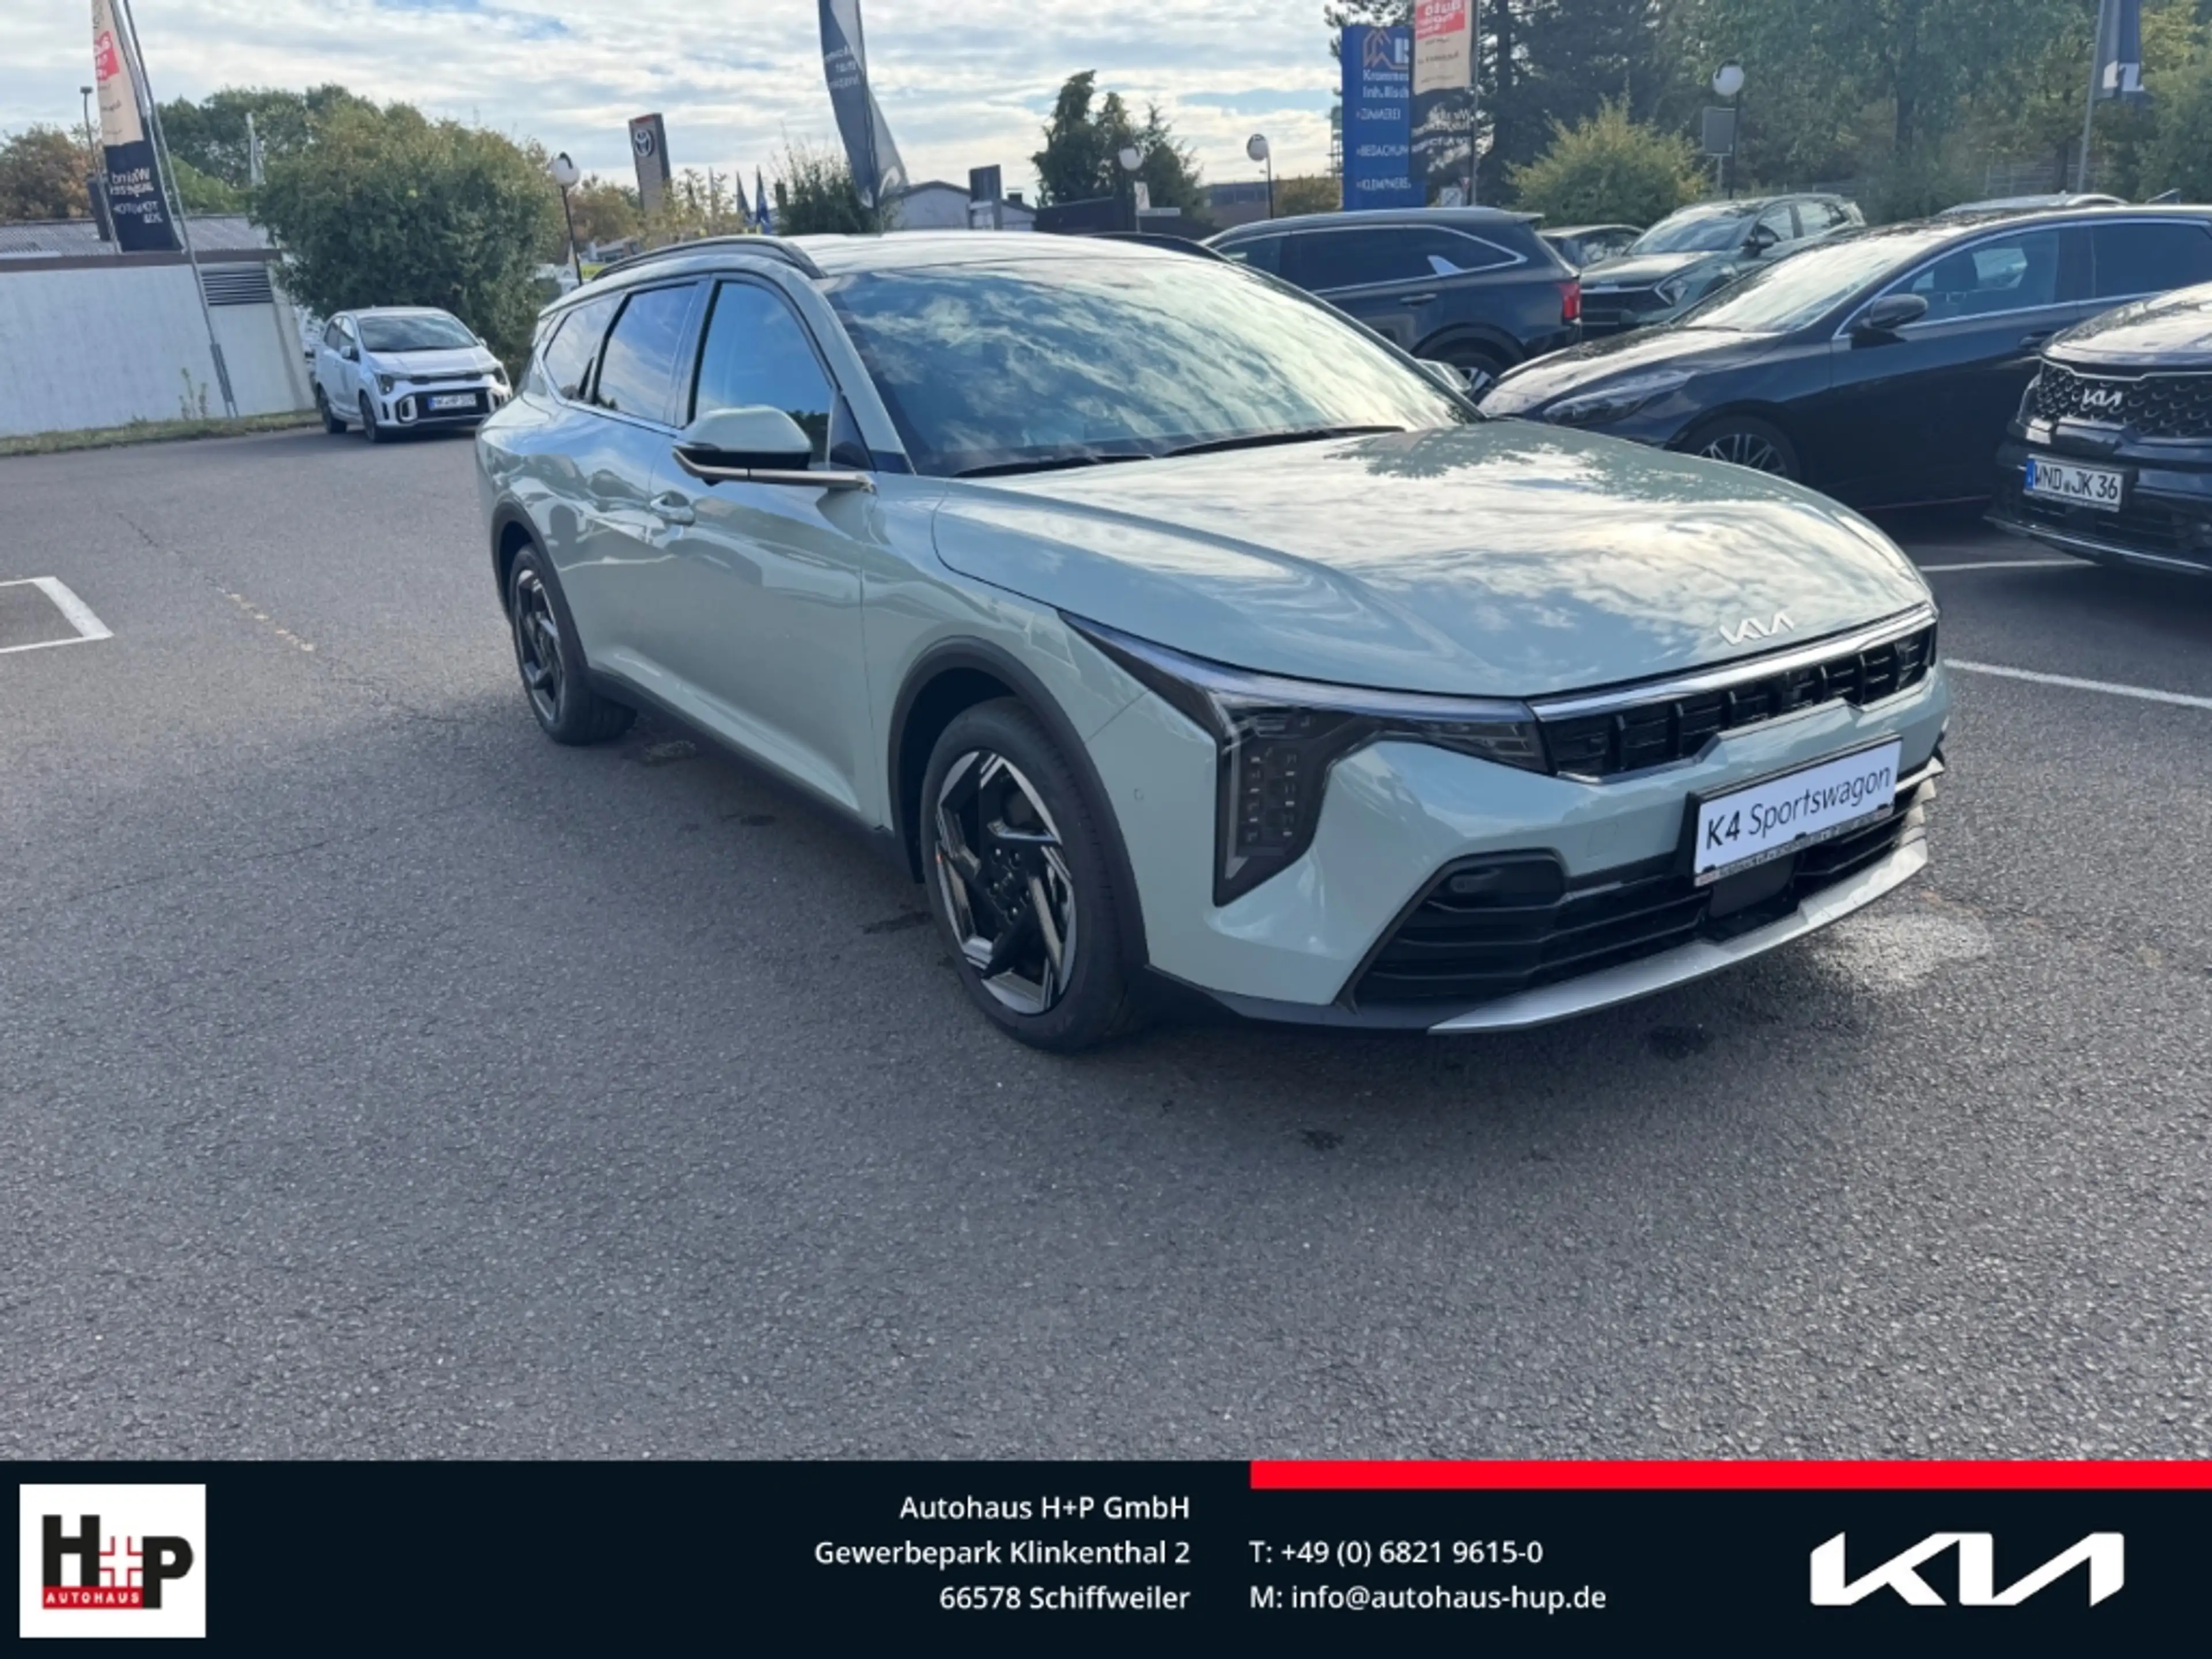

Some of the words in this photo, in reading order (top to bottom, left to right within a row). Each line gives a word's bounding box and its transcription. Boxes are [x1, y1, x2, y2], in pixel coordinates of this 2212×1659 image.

[2034, 463, 2062, 490] WND
[2071, 470, 2093, 497] JK
[2096, 474, 2118, 500] 36
[1718, 611, 1796, 645] KIA
[1706, 810, 1741, 850] K4
[1748, 765, 1891, 839] Sportswagon
